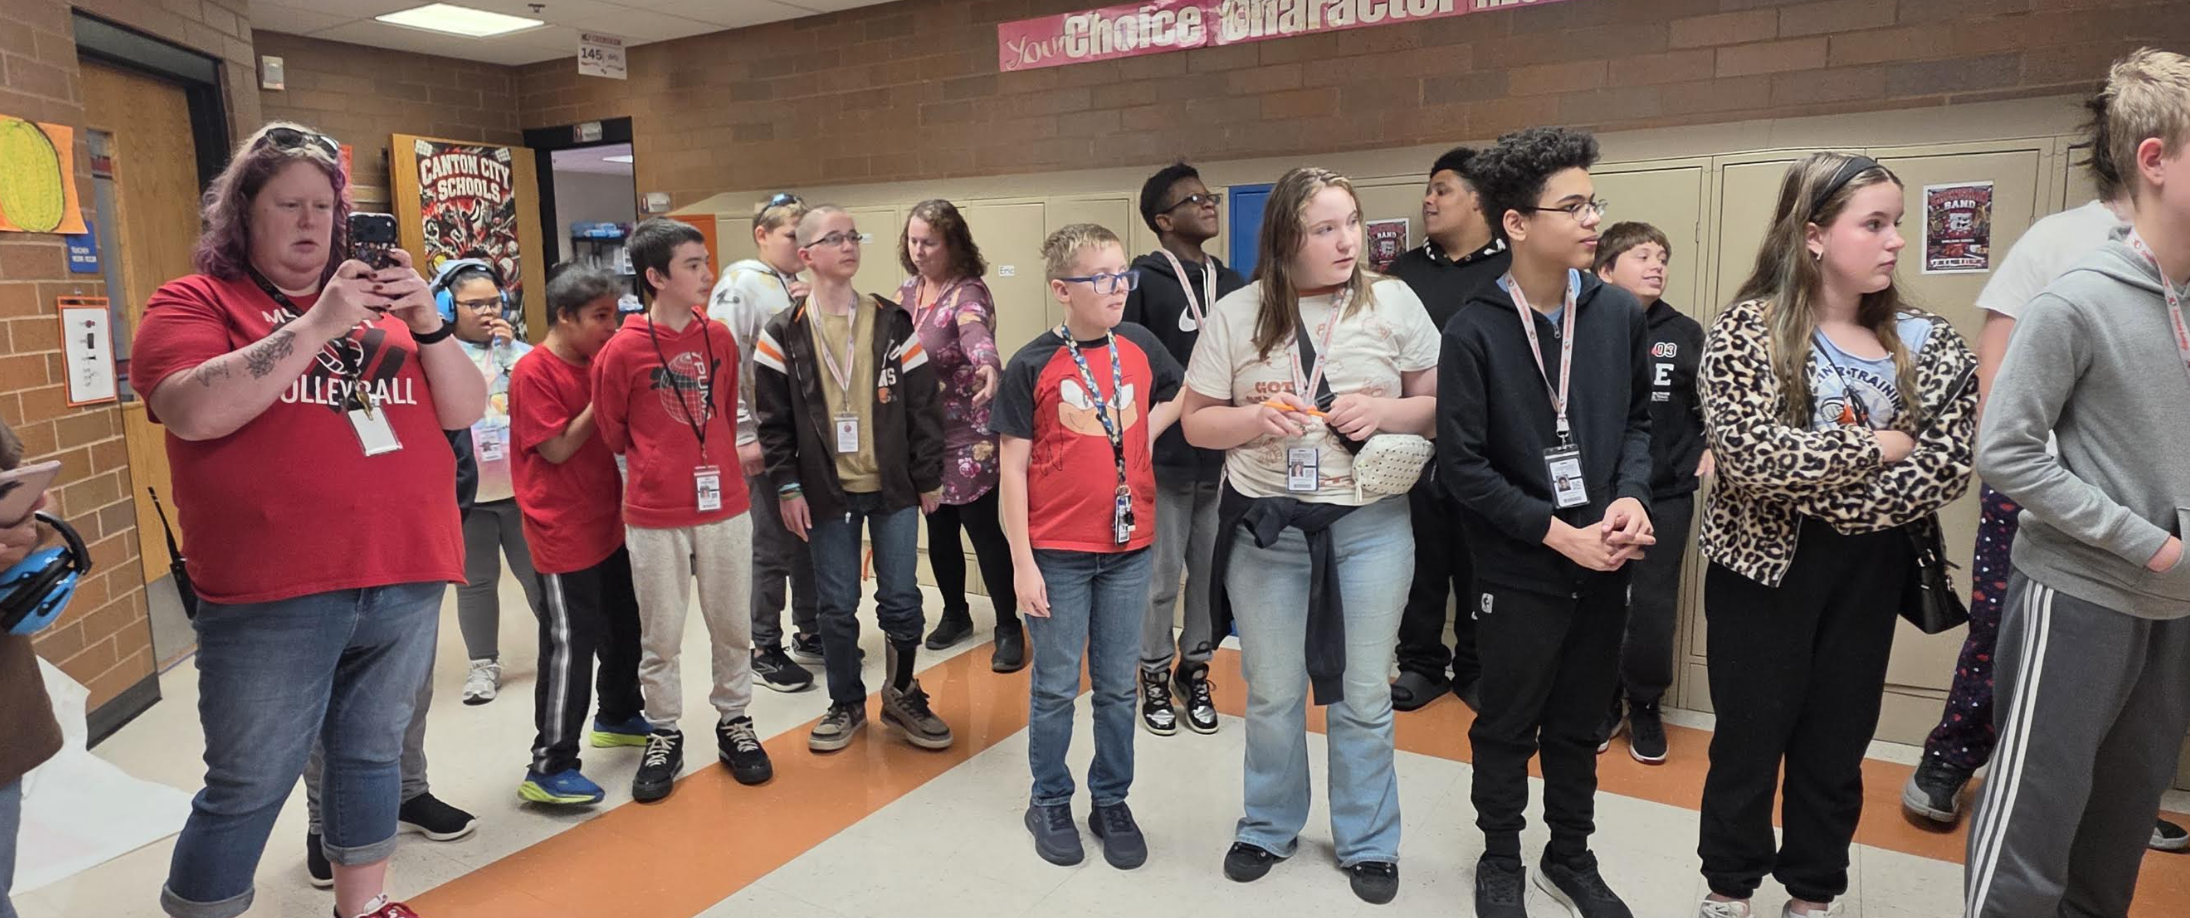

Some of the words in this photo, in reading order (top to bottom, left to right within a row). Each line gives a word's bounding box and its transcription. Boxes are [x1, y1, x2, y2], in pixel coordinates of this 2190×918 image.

[1006, 33, 1072, 71] Your
[1064, 6, 1201, 58] Choice
[581, 47, 602, 61] 145
[420, 153, 479, 186] CANTON
[480, 157, 511, 190] CITY
[437, 176, 501, 204] SCHOOLS
[1944, 199, 1976, 209] BAND
[1653, 363, 1675, 386] E
[280, 373, 418, 406] OLLEYALL
